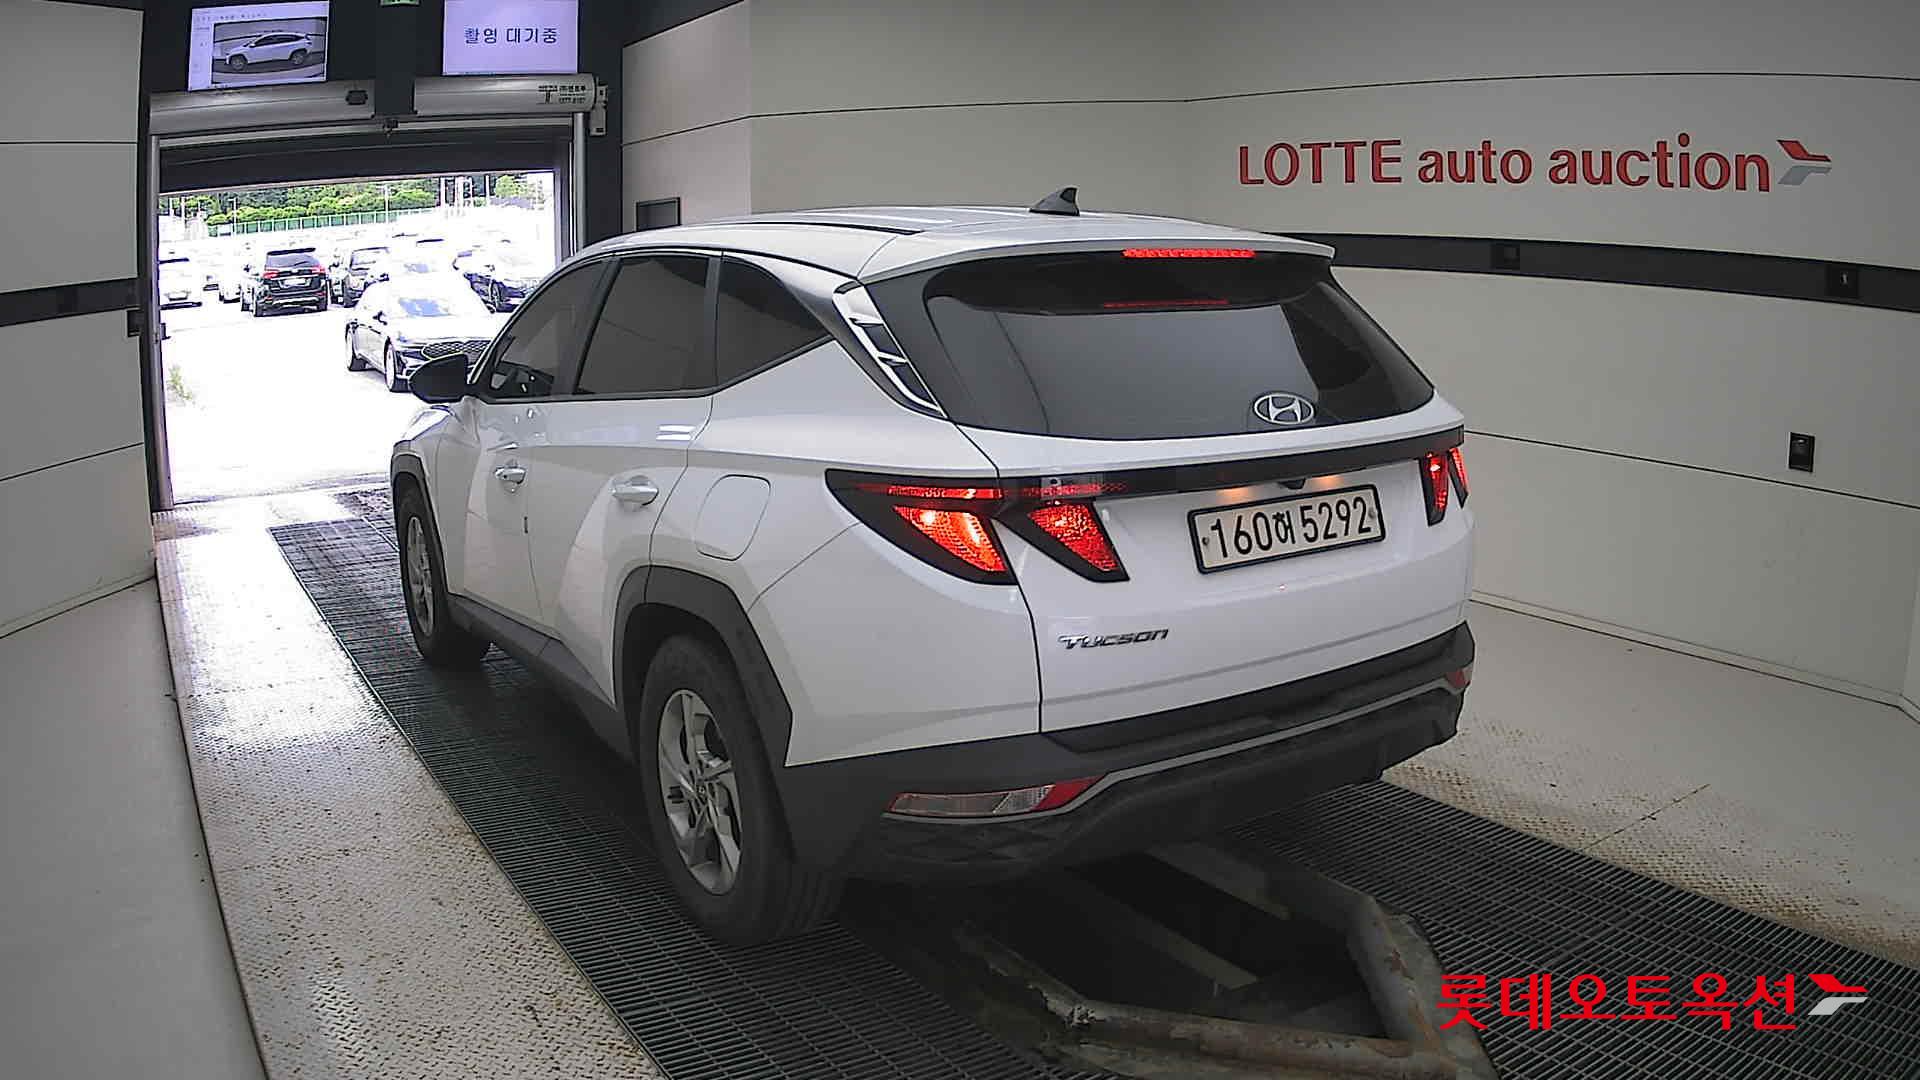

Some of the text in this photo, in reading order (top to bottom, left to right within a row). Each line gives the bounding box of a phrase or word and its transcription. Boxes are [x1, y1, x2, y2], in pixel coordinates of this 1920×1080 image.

[464, 27, 498, 45] 촬영
[1238, 132, 1771, 193] LOTTE auto auction
